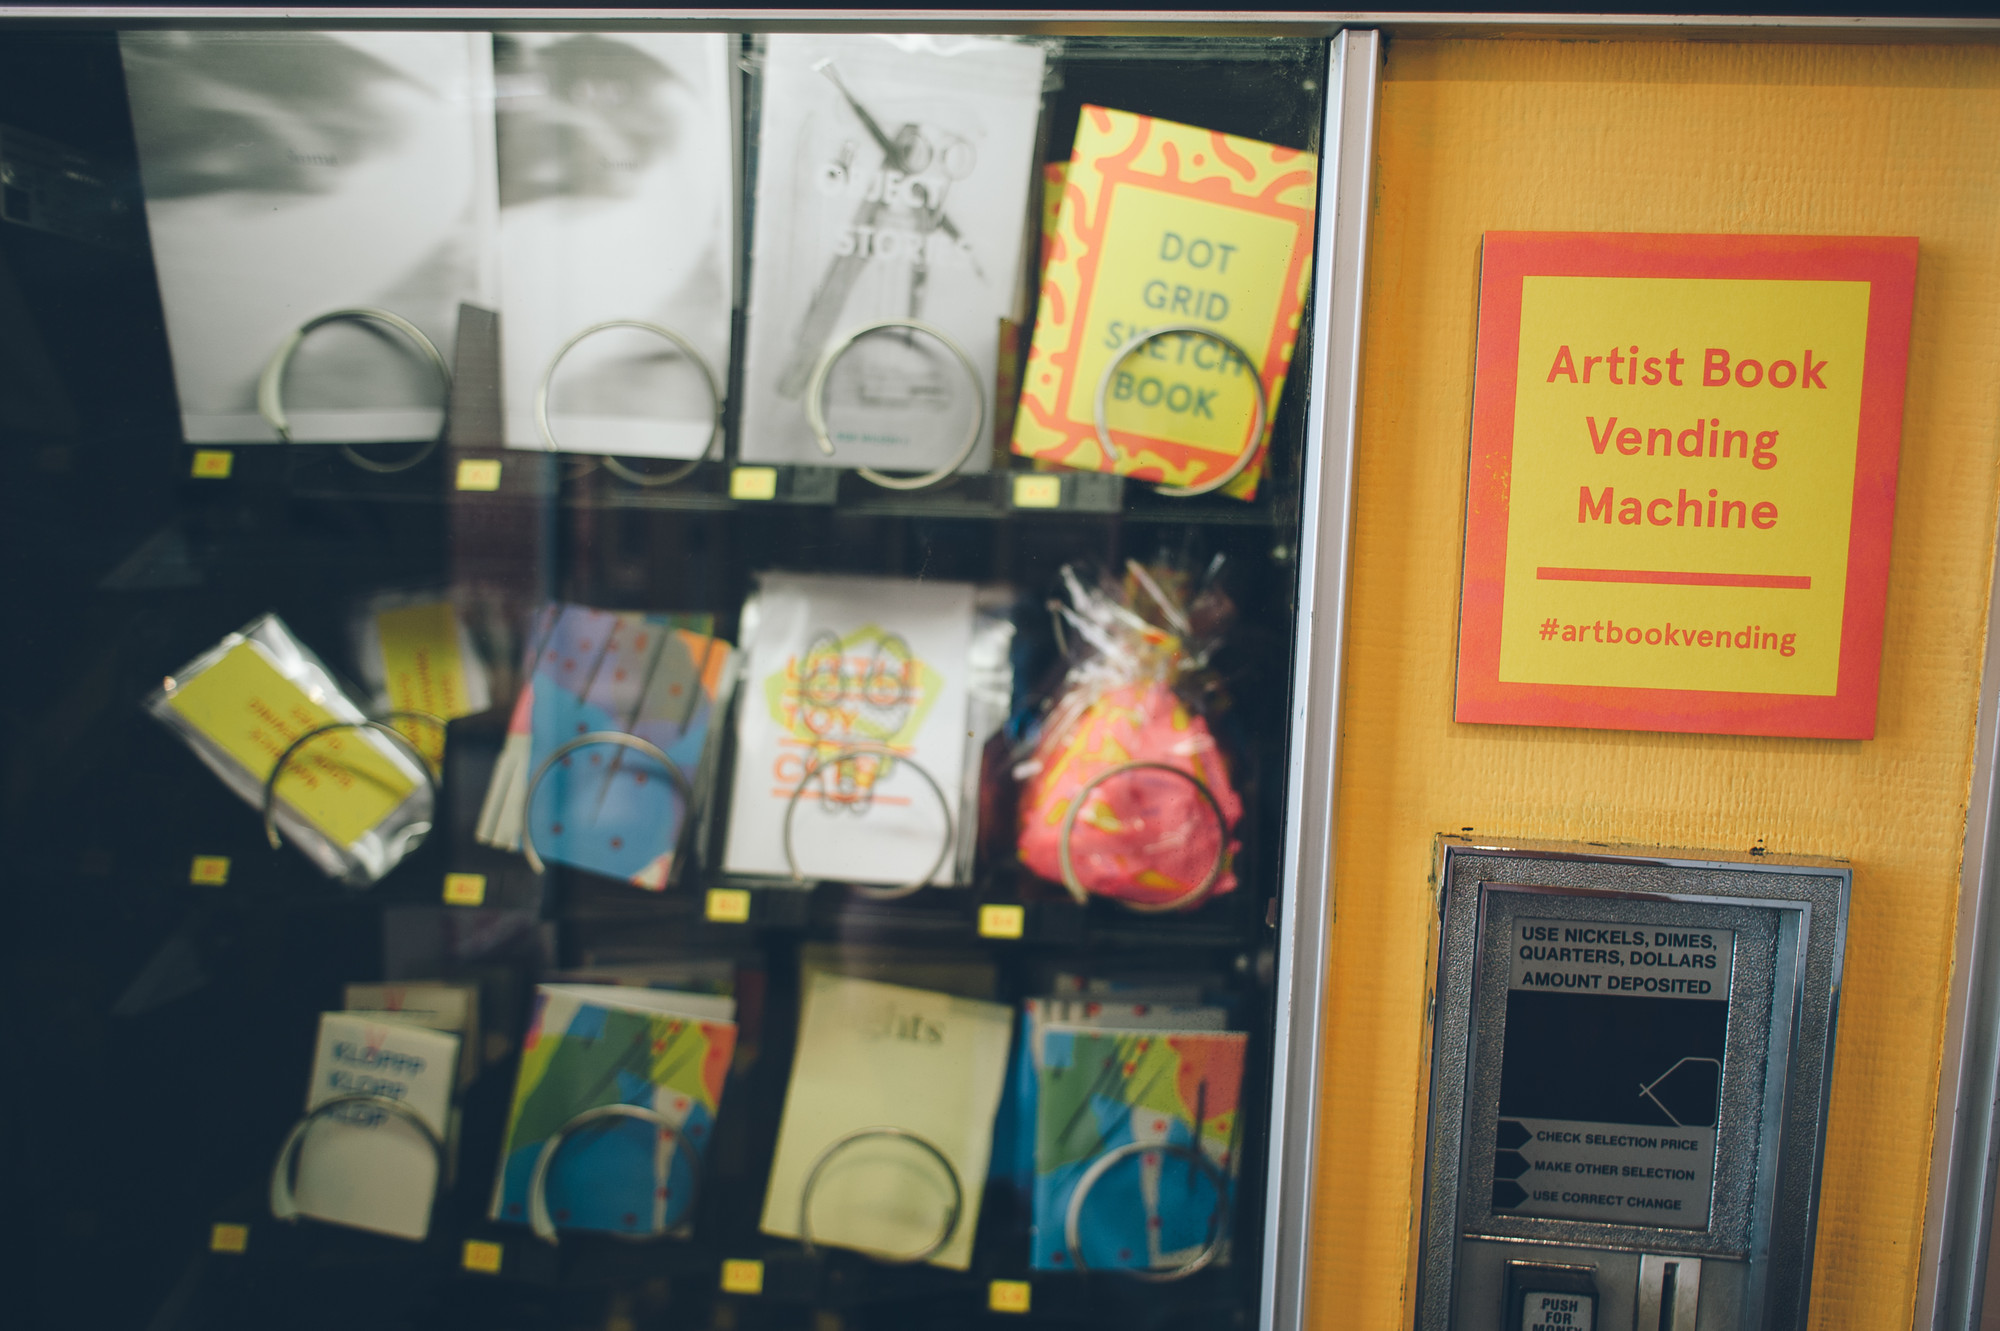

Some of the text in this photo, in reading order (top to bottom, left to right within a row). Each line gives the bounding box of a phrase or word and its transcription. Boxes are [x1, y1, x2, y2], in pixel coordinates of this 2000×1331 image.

[1158, 232, 1237, 274] DOT
[1142, 280, 1229, 322] GRID
[1546, 345, 1829, 390] Artist Book
[1111, 371, 1218, 419] BOOK
[1585, 416, 1780, 470] Vending
[1578, 486, 1779, 530] Machine
[1538, 618, 1797, 657] #artbookvending
[1521, 926, 1718, 951] USE NICKELS, DIMES,
[1519, 945, 1717, 969] QUARTERS, DOLLARS
[1521, 971, 1712, 995] AMOUNT DEPOSITED
[1536, 1130, 1699, 1151] CHECK SELECTION PRICE
[1534, 1160, 1695, 1181] MAKE OTHER SELECTION
[1532, 1190, 1682, 1211] USE CORRECT CHANGE
[1542, 1298, 1578, 1313] PUSH
[1545, 1311, 1572, 1325] FOR
